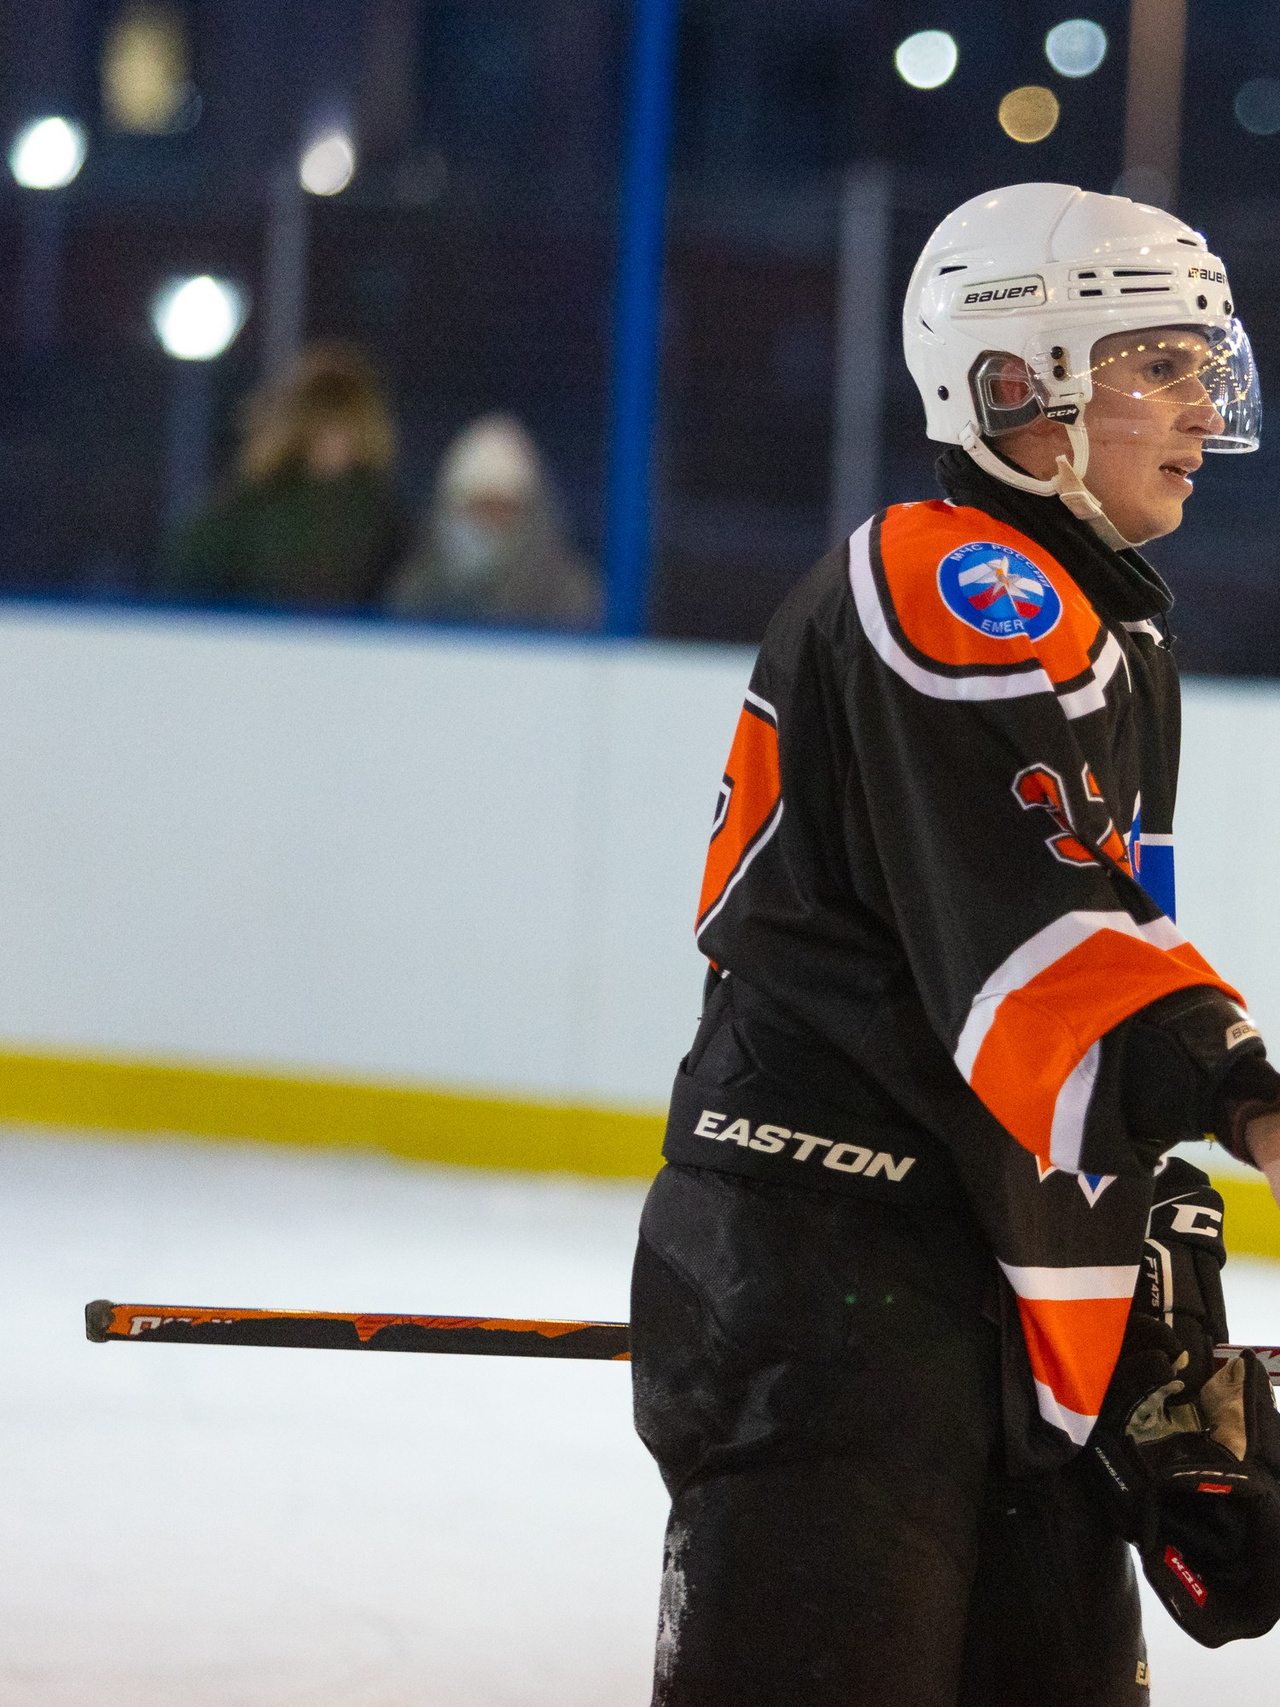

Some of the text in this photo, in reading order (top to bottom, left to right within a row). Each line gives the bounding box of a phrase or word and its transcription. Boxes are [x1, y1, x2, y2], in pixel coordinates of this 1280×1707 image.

[964, 285, 1038, 304] BAUER
[1047, 408, 1077, 418] CCM
[950, 544, 1050, 588] МЧС РОССИИ
[694, 1110, 915, 1182] EASTON
[1171, 1556, 1203, 1597] CCM
